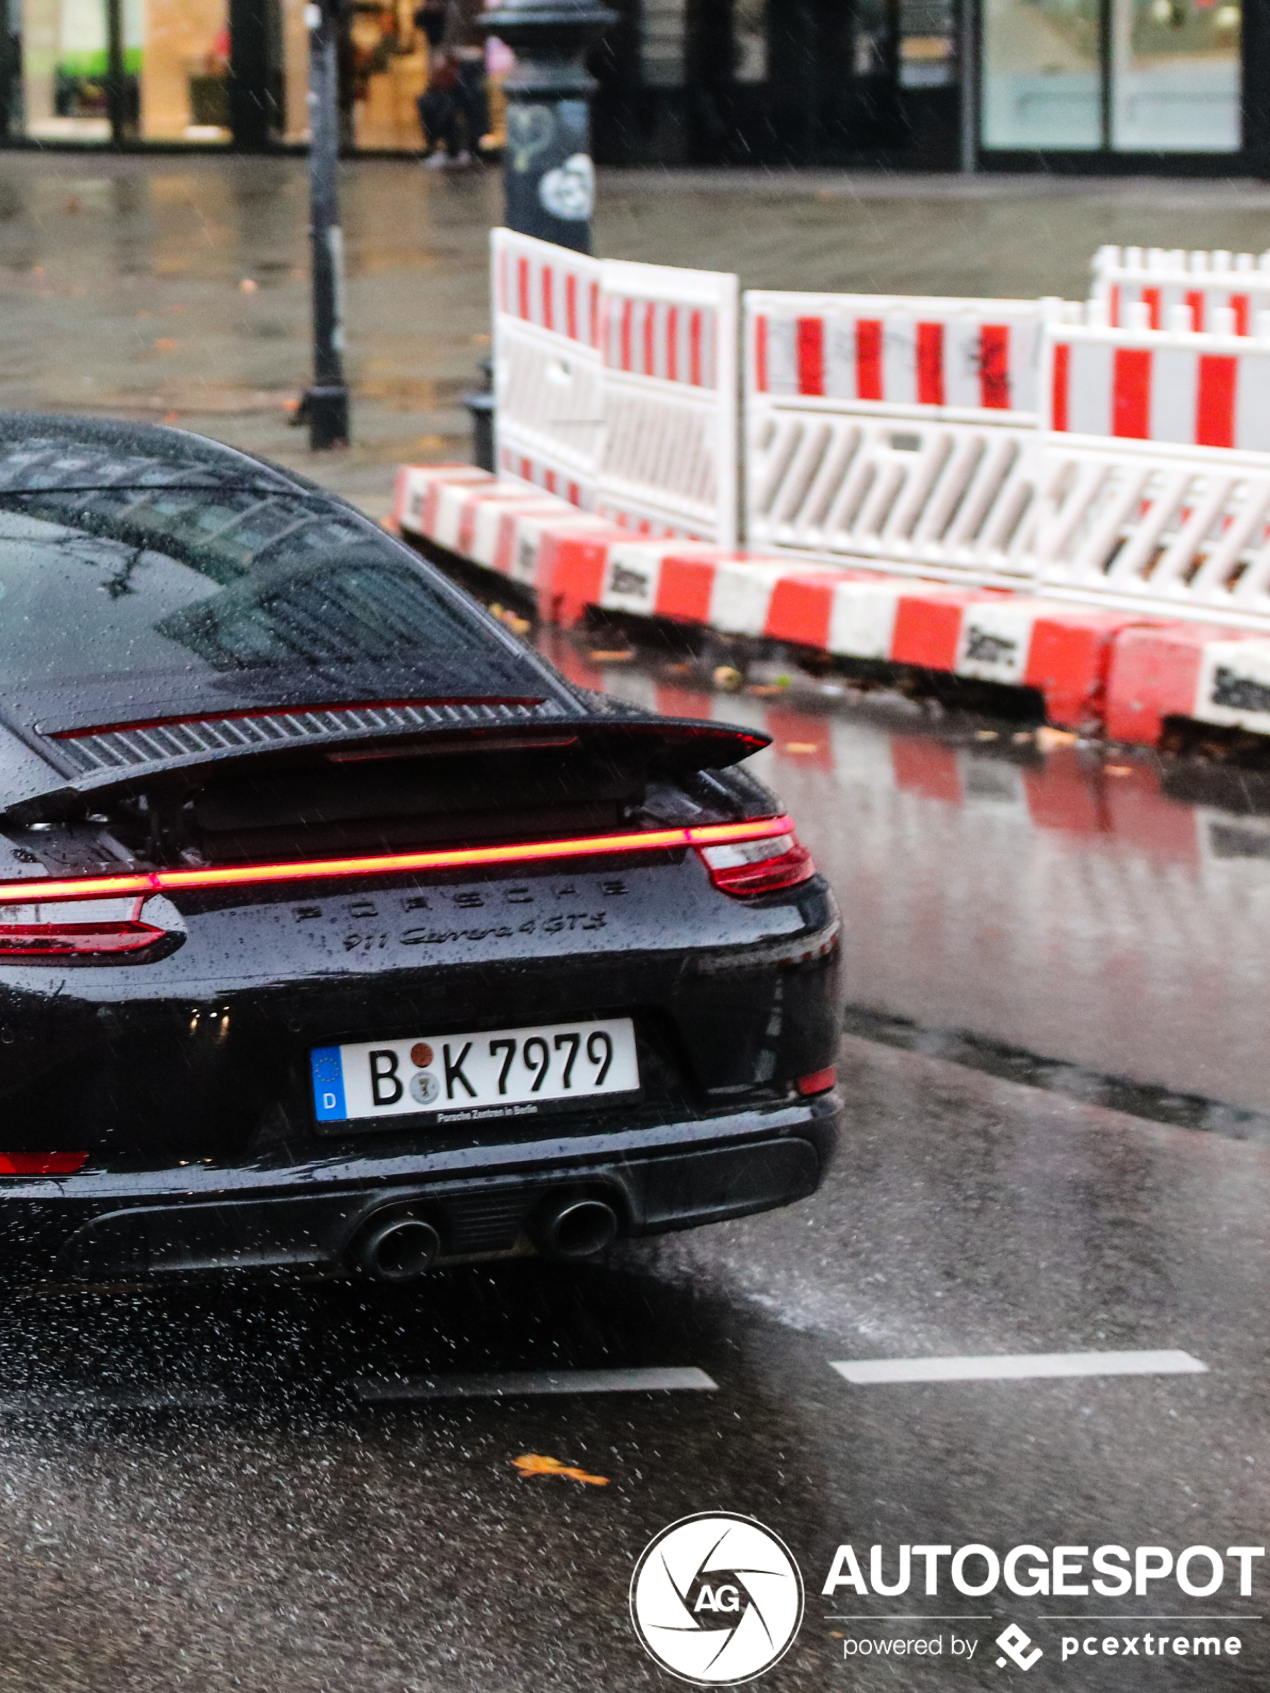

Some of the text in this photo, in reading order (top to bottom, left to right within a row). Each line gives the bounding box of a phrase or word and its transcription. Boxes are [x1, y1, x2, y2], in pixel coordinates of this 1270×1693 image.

[292, 880, 628, 923] PORSCHE
[343, 911, 608, 951] 911 Carrera 4 GTS
[368, 1030, 613, 1106] B K 7979
[323, 1092, 337, 1110] D
[436, 1104, 538, 1124] Porsche Zentren in Berlin
